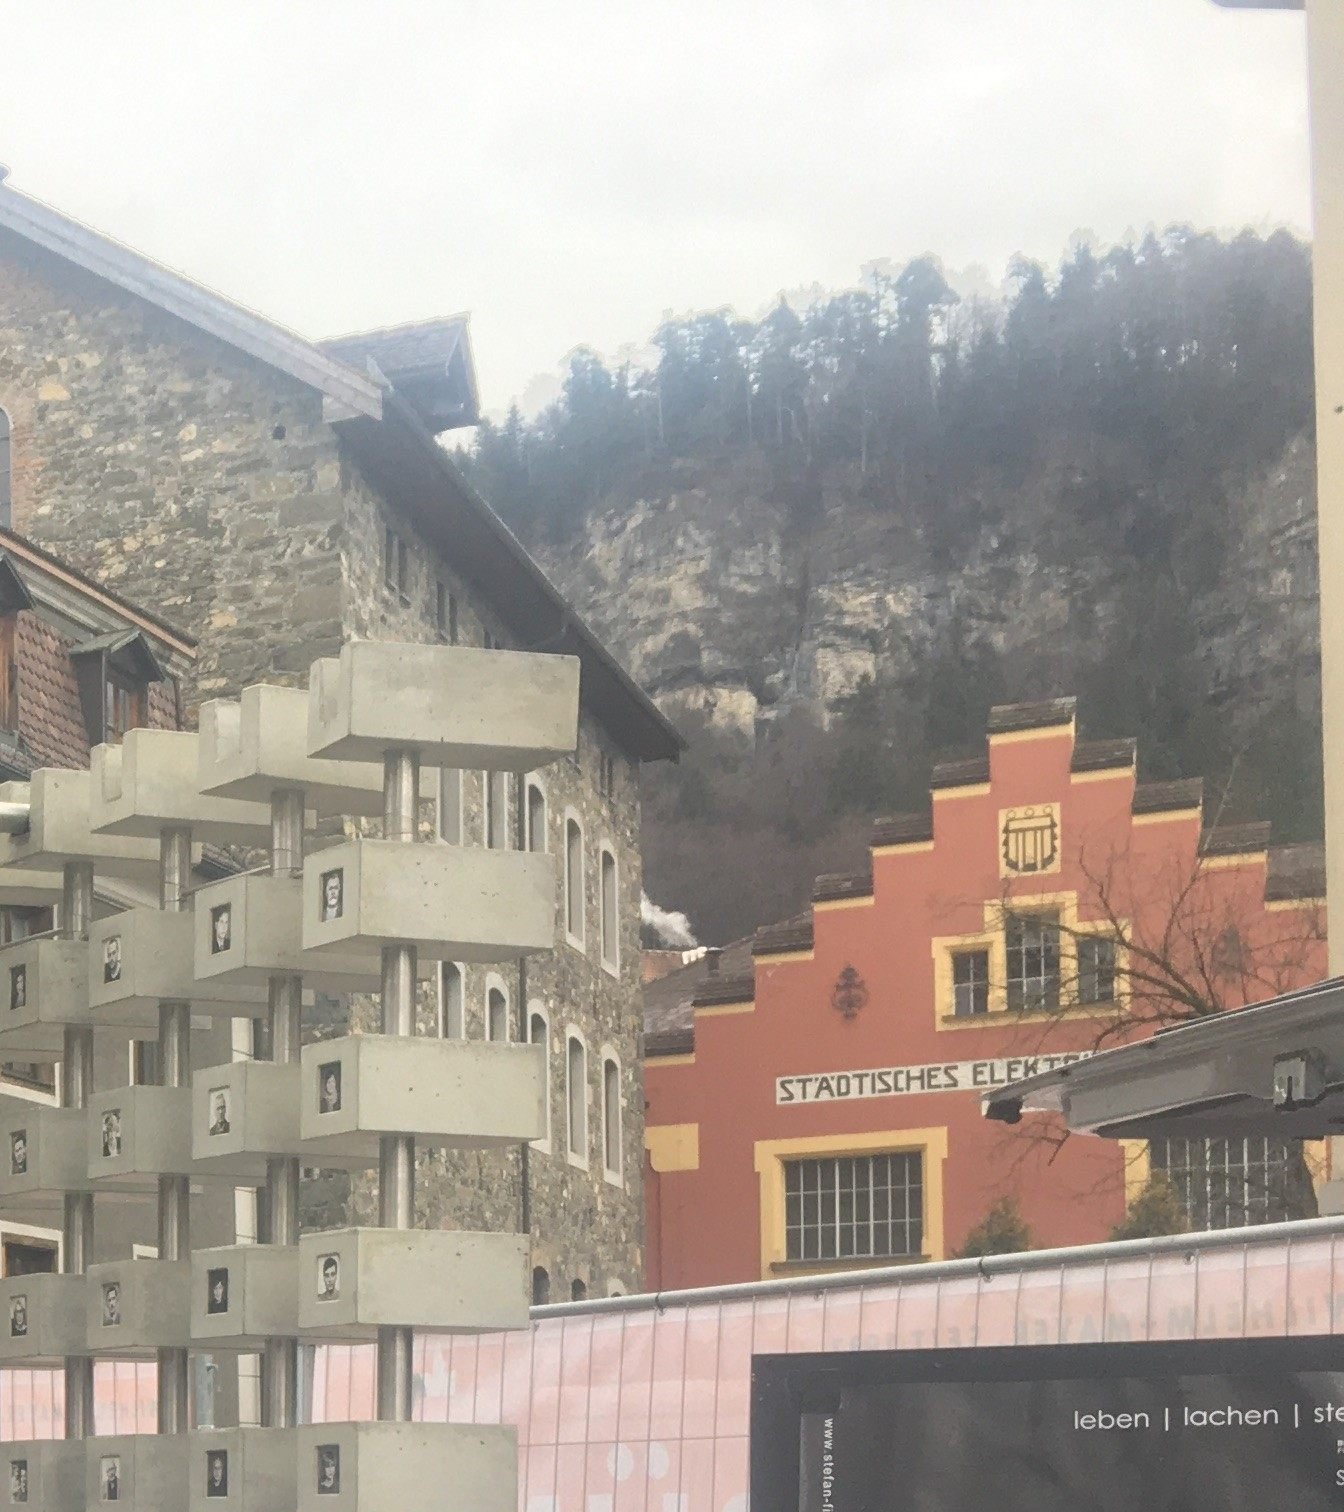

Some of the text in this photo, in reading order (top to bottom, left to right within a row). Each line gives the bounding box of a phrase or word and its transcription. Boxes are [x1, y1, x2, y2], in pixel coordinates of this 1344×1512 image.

[779, 1064, 960, 1103] STÄDTISCHES
[1074, 1409, 1150, 1430] leben
[1183, 1405, 1279, 1426] lachen
